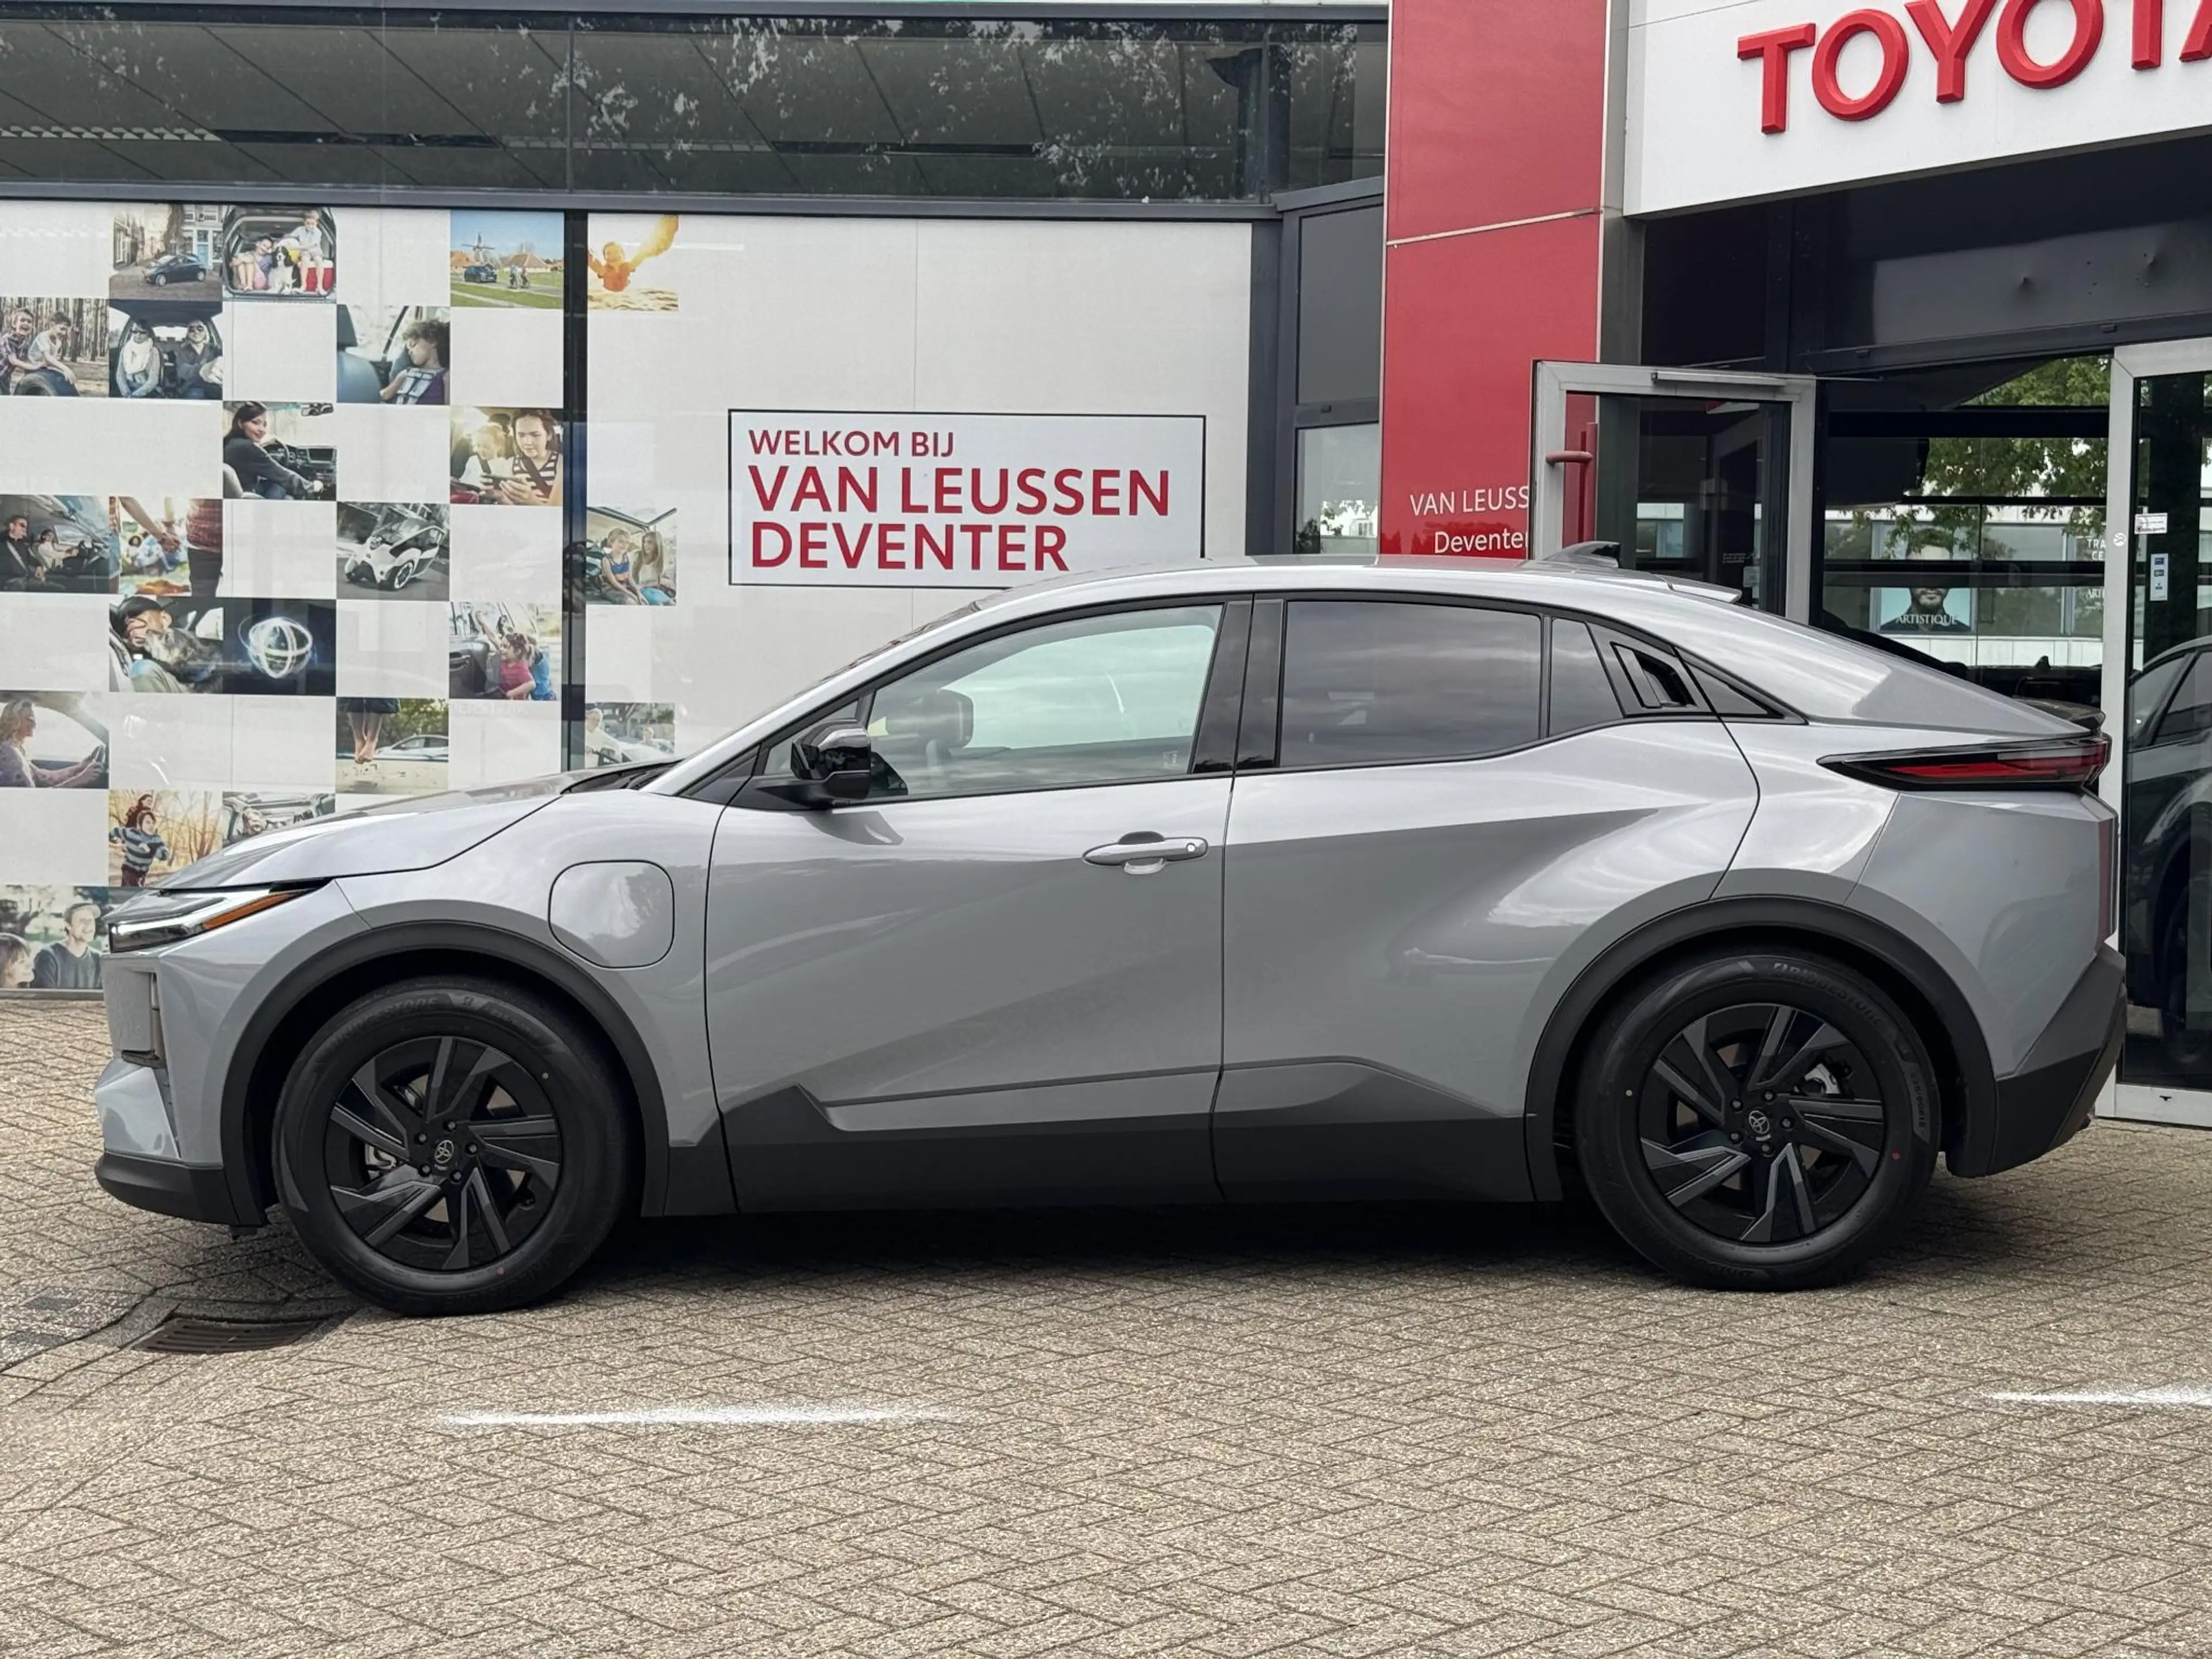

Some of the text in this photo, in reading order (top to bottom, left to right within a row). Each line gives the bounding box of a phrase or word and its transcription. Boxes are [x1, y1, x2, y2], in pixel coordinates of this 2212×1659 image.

[749, 430, 955, 457] WELKOM BIJ
[748, 465, 1169, 516] VAN LEUSSEN
[1410, 491, 1455, 517] VAN
[752, 521, 1070, 571] DEVENTER
[1895, 613, 1957, 627] ARTISTIQUE
